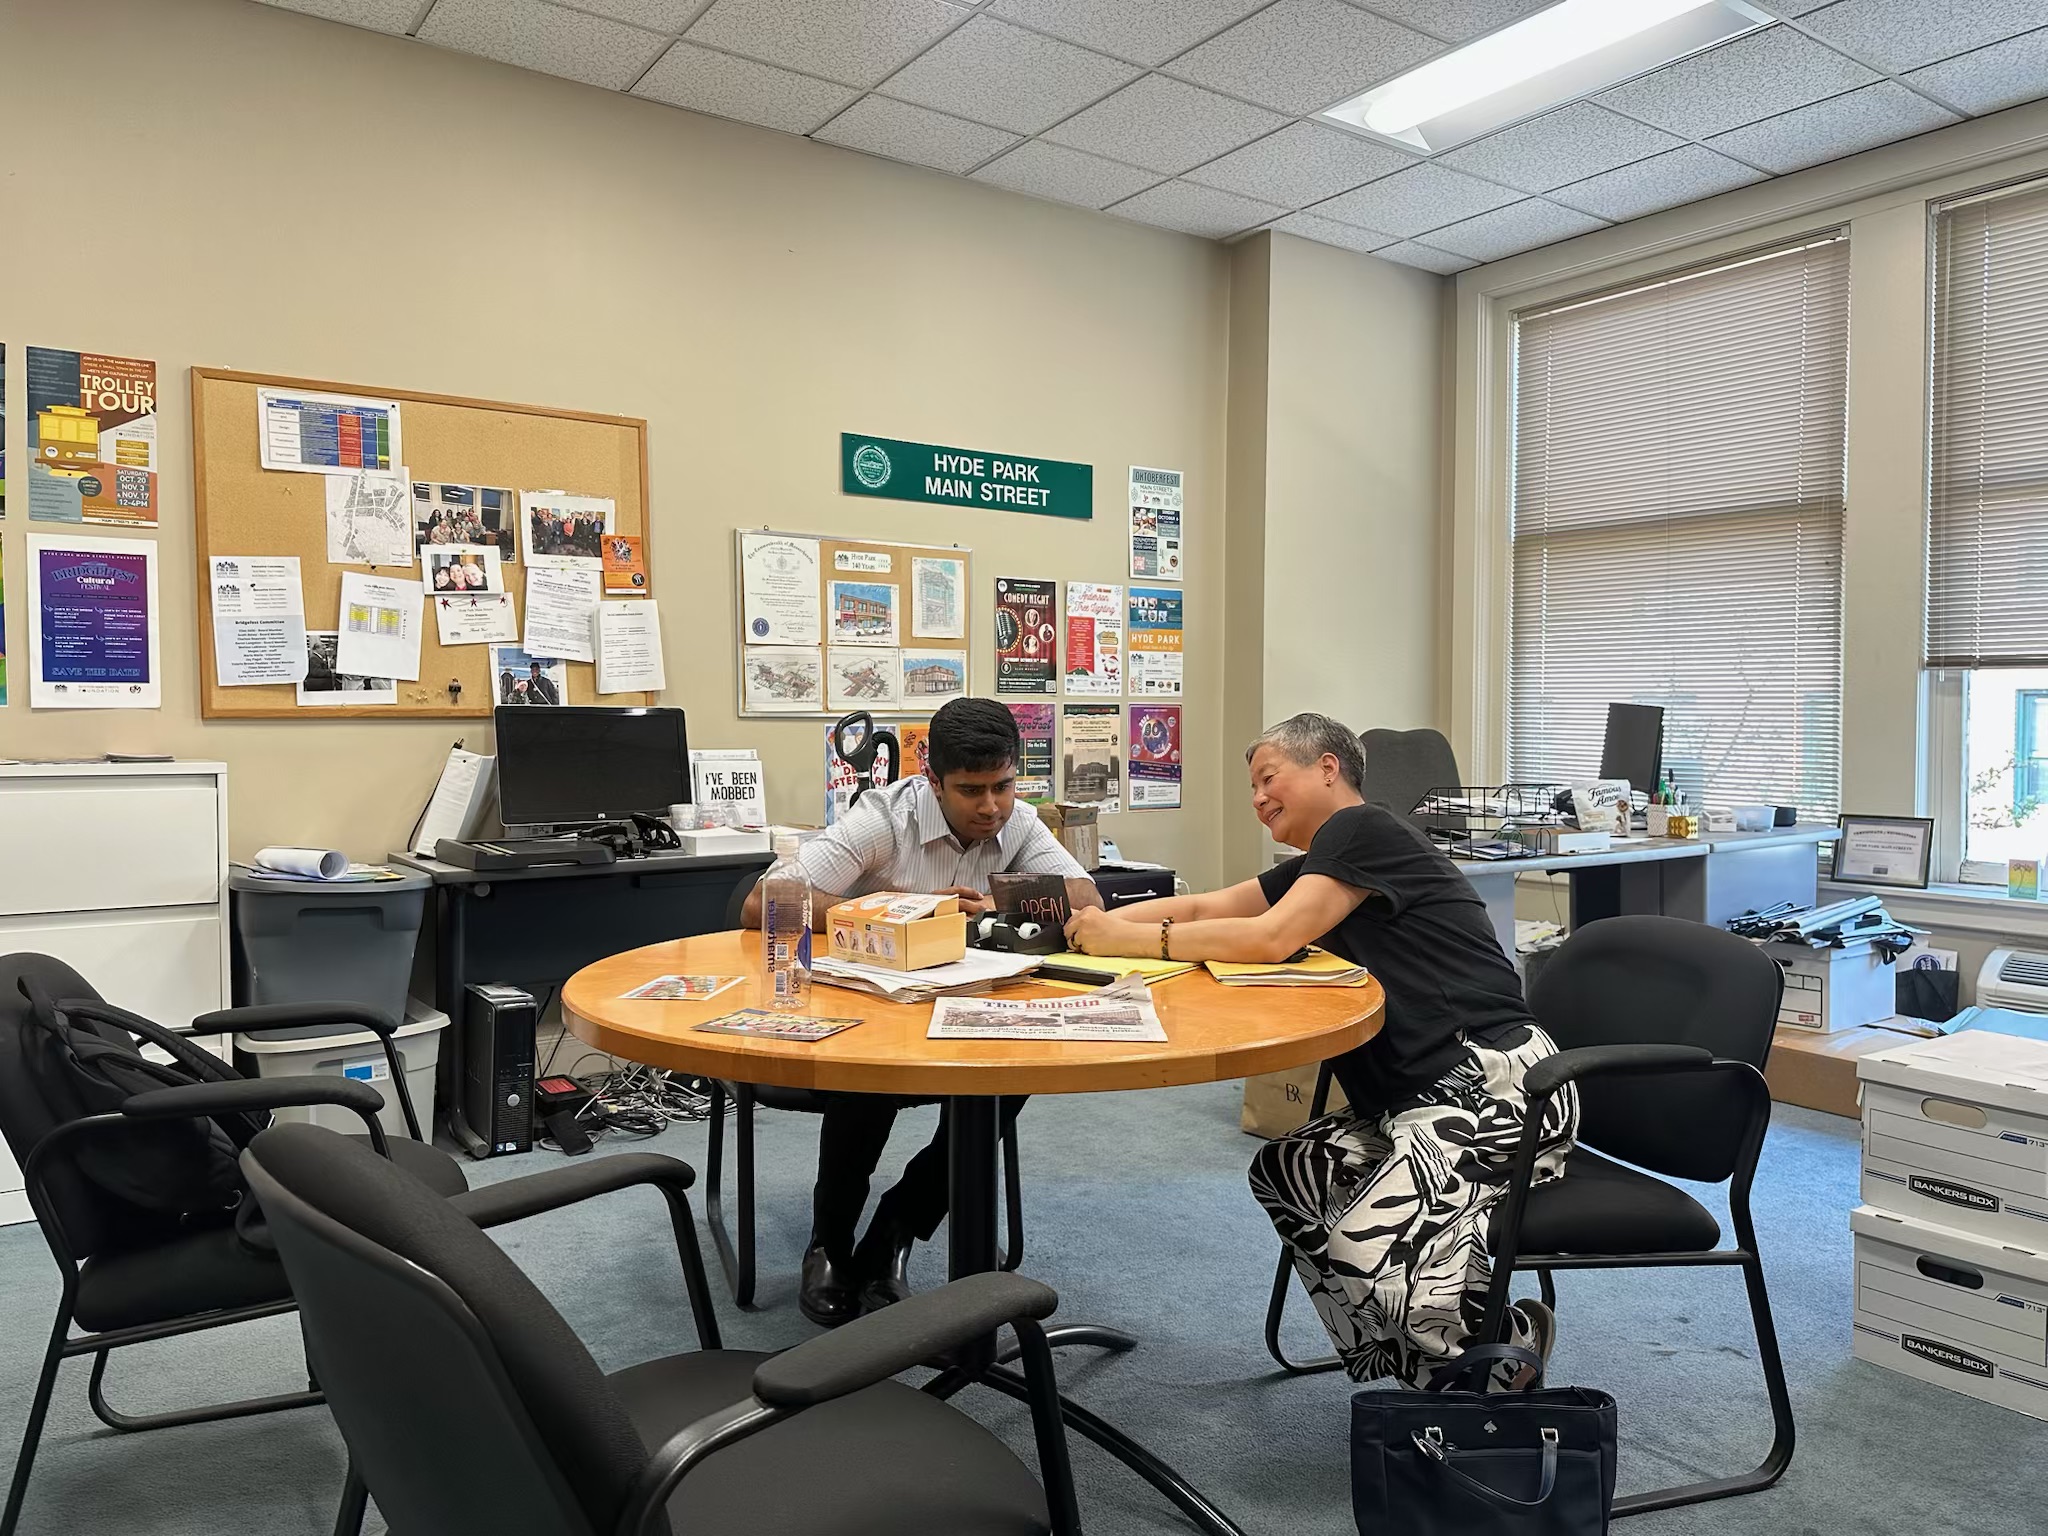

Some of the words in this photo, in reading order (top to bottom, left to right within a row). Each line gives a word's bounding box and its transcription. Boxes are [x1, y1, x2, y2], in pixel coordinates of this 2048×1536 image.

[80, 373, 154, 396] TROLLEY
[80, 388, 154, 415] TOUR
[116, 469, 149, 477] SATURDAYS
[934, 452, 985, 478] HYDE
[992, 462, 1040, 484] PARK
[120, 476, 136, 484] OCT.
[137, 476, 147, 484] 20
[1135, 471, 1178, 485] OKTOBERFEST
[140, 484, 145, 492] 3
[924, 476, 973, 499] MAIN
[980, 482, 1050, 508] STREET
[122, 491, 140, 499] NOV.
[140, 492, 150, 500] 17
[118, 499, 148, 508] 12-4PM
[51, 565, 140, 584] BRIDGEFEST
[76, 576, 115, 585] Cultural
[1004, 592, 1028, 604] COMEDY
[1029, 594, 1050, 605] NIGHT
[1131, 632, 1154, 644] HYDE
[1158, 634, 1180, 645] PARK
[52, 667, 82, 676] SAVE
[85, 668, 106, 677] THE
[108, 668, 140, 677] DATE!
[705, 772, 724, 786] I'VE
[731, 771, 758, 786] BEEN
[710, 786, 756, 800] MOBBED
[1588, 786, 1622, 802] Famous
[1020, 896, 1065, 926] OPEN
[1025, 1000, 1100, 1009] Bulletin
[1286, 1082, 1303, 1104] BR
[1913, 1180, 1968, 1200] BANKERS
[1968, 1194, 1994, 1208] BOX
[1906, 1340, 1962, 1364] BANKERS
[1962, 1358, 1989, 1373] BOX
